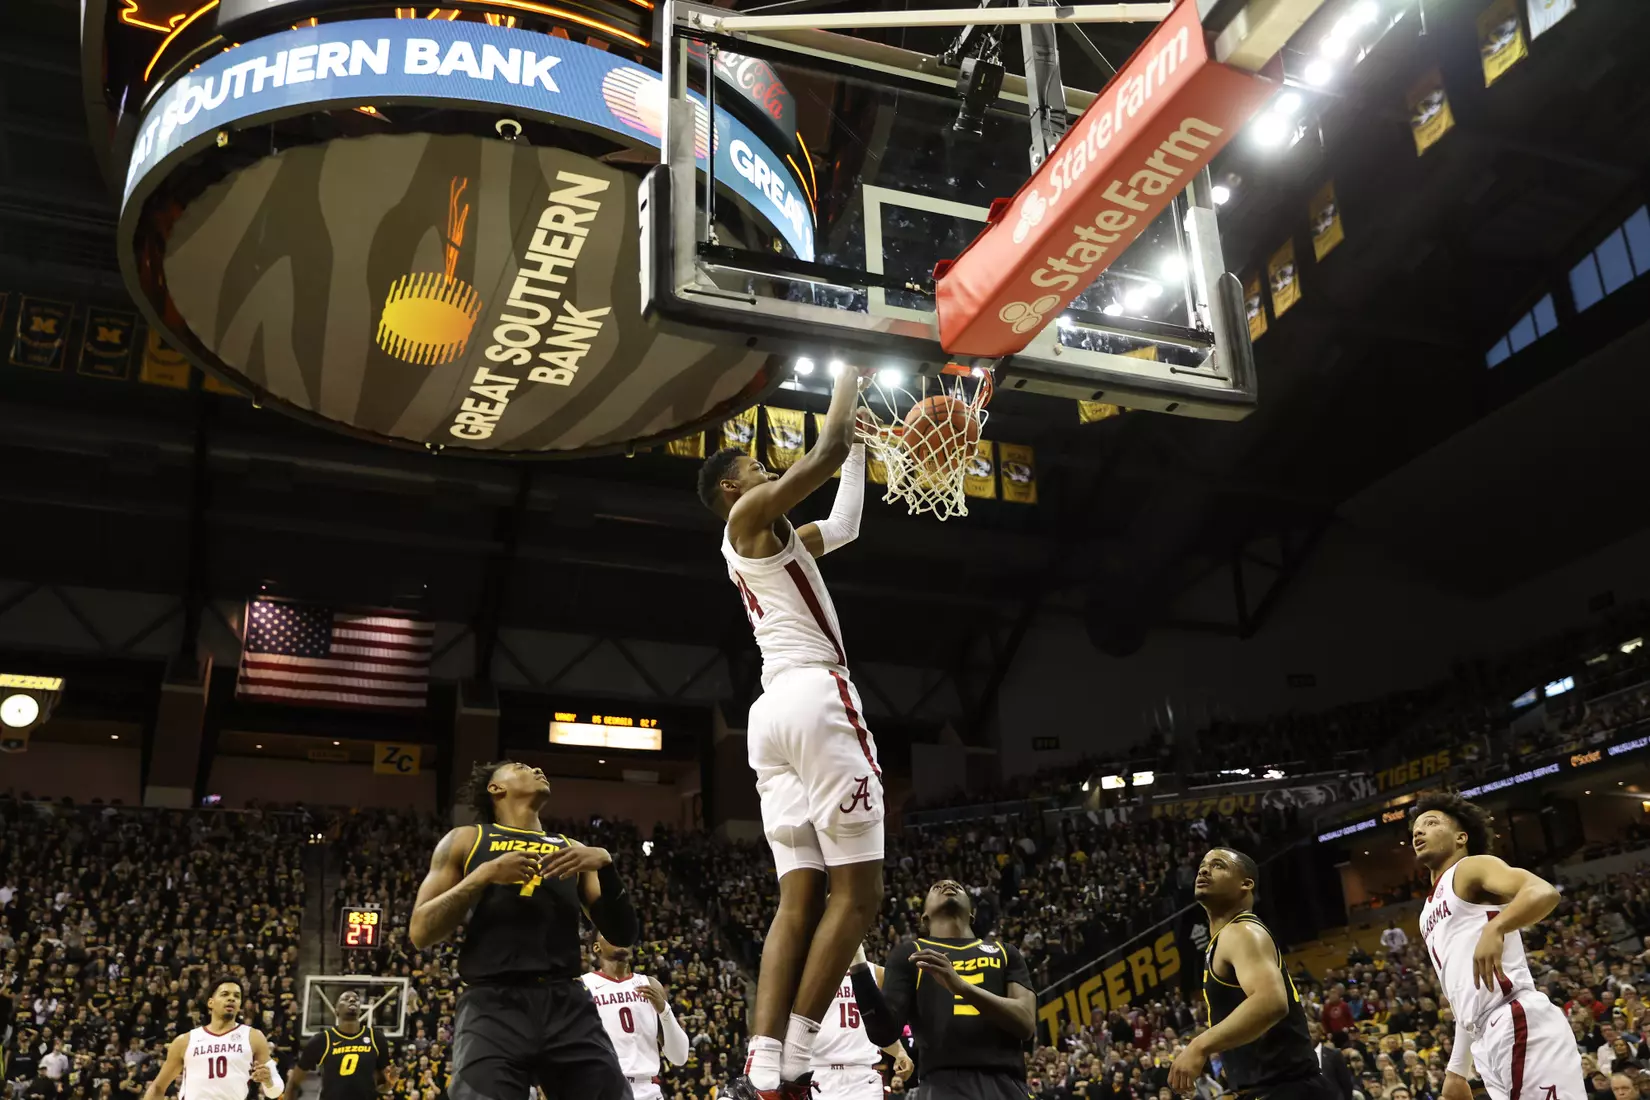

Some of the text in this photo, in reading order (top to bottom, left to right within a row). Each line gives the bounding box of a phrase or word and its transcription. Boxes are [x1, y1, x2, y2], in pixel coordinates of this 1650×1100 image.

[165, 38, 389, 139] SOUTHERN
[404, 38, 562, 94] BANK
[729, 139, 807, 240] GREAT
[449, 170, 611, 441] GREAT SOUTHERN
[527, 300, 612, 387] BANK
[1375, 750, 1451, 792] TIGERS
[1514, 771, 1534, 784] GOOD
[347, 924, 373, 944] 27
[951, 956, 1001, 972] ZZOU
[1038, 930, 1181, 1046] TIGERS
[618, 1006, 636, 1034] 0
[839, 1003, 861, 1029] 15
[193, 1043, 243, 1057] ALABAMA
[331, 1045, 372, 1056] MIZZOU
[208, 1056, 228, 1079] 10
[339, 1053, 360, 1077] 0
